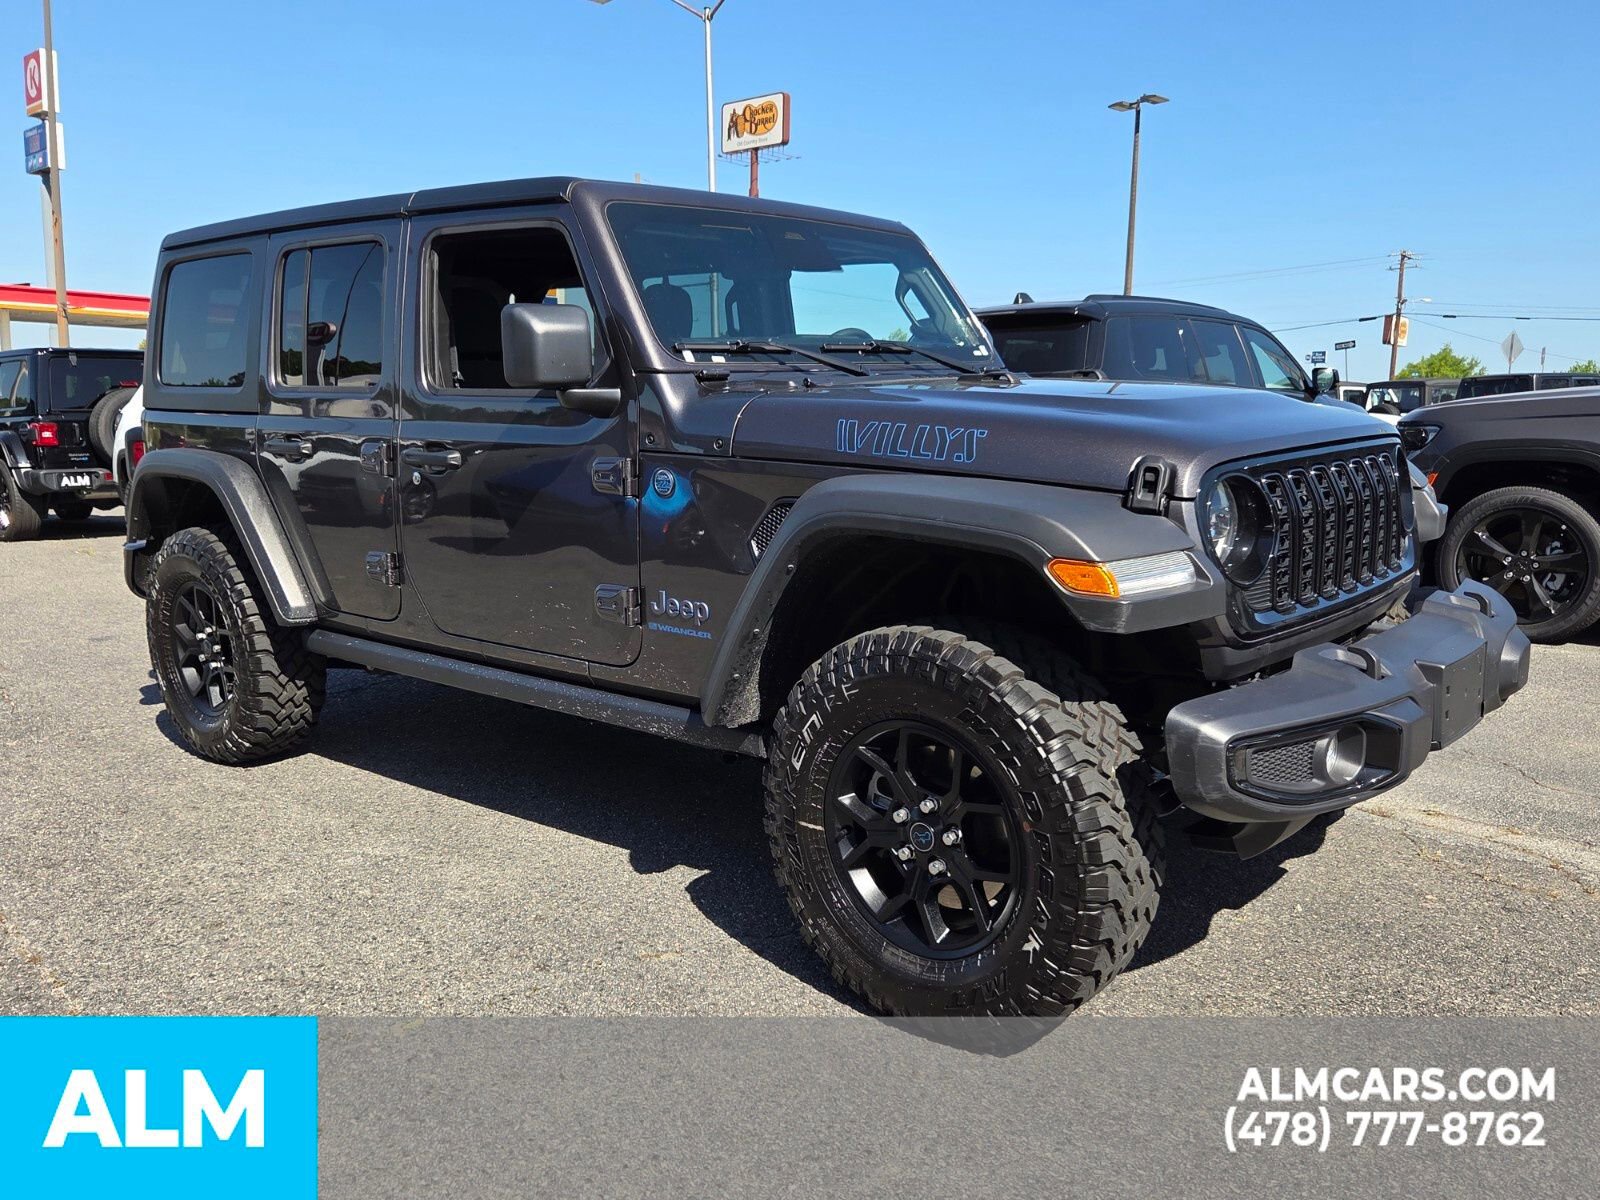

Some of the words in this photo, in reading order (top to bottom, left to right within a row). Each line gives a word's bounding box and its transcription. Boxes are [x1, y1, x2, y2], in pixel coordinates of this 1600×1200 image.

[29, 65, 39, 90] K
[836, 419, 988, 463] WILLYS
[61, 475, 91, 487] ALM
[650, 590, 709, 627] Jeep
